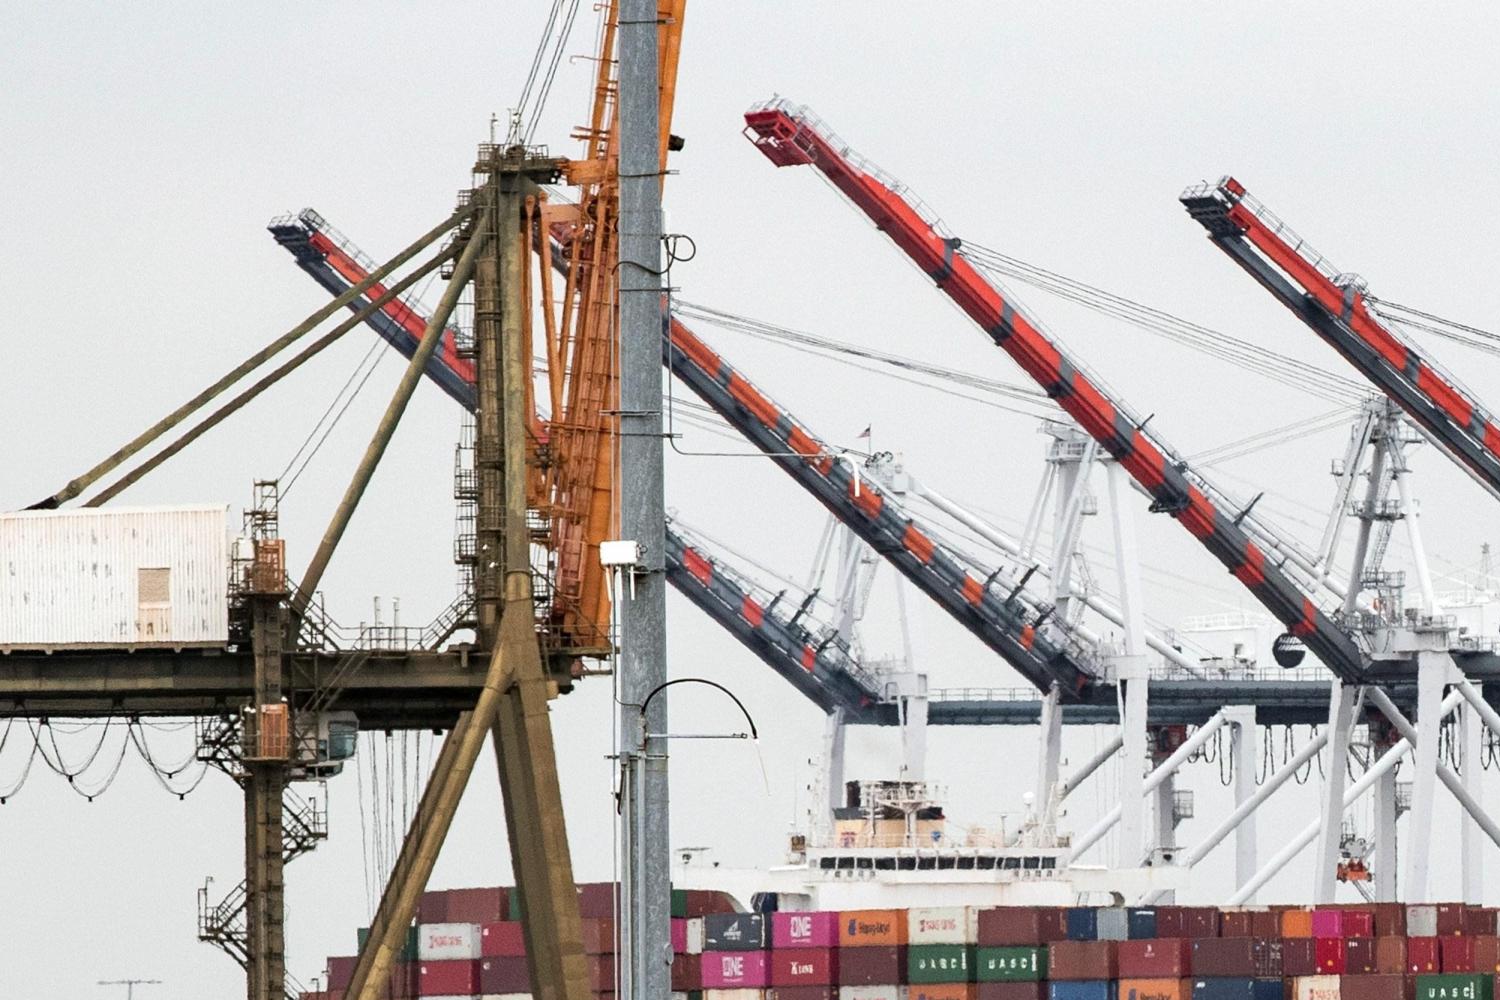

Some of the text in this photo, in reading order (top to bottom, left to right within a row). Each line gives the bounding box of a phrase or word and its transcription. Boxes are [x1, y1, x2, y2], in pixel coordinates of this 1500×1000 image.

[791, 916, 811, 937] ONE
[722, 957, 744, 976] ONE
[1428, 987, 1470, 998] UASC
